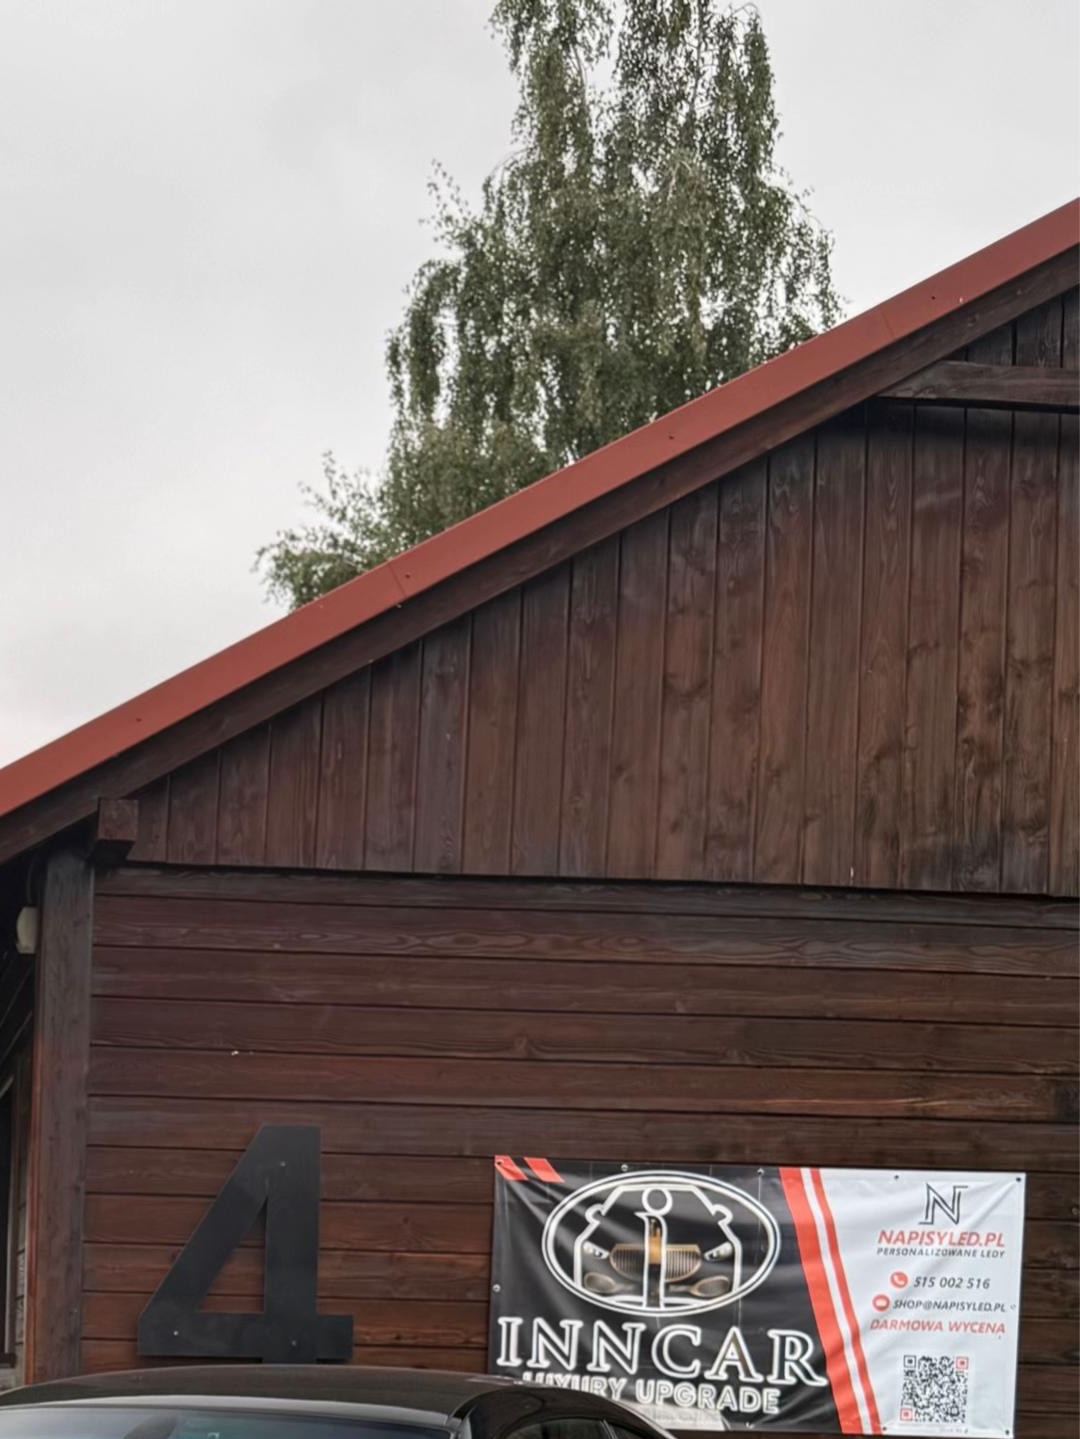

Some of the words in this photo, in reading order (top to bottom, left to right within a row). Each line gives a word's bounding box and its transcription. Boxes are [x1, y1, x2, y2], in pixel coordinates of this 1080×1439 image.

[136, 1124, 354, 1365] 4
[877, 1230, 1005, 1247] NAPISYLED.PL
[876, 1247, 977, 1258] PERSONALIZOWANE
[980, 1250, 1005, 1258] LEDY
[913, 1276, 936, 1288] 515
[939, 1276, 963, 1290] 002
[966, 1278, 991, 1290] 516
[892, 1299, 1006, 1312] SHOP@NAPISYLED.PL
[870, 1319, 943, 1331] DARMOWA
[948, 1321, 1006, 1333] WYCENA
[496, 1316, 828, 1387] INNCAR
[634, 1378, 783, 1415] UPGRADE
